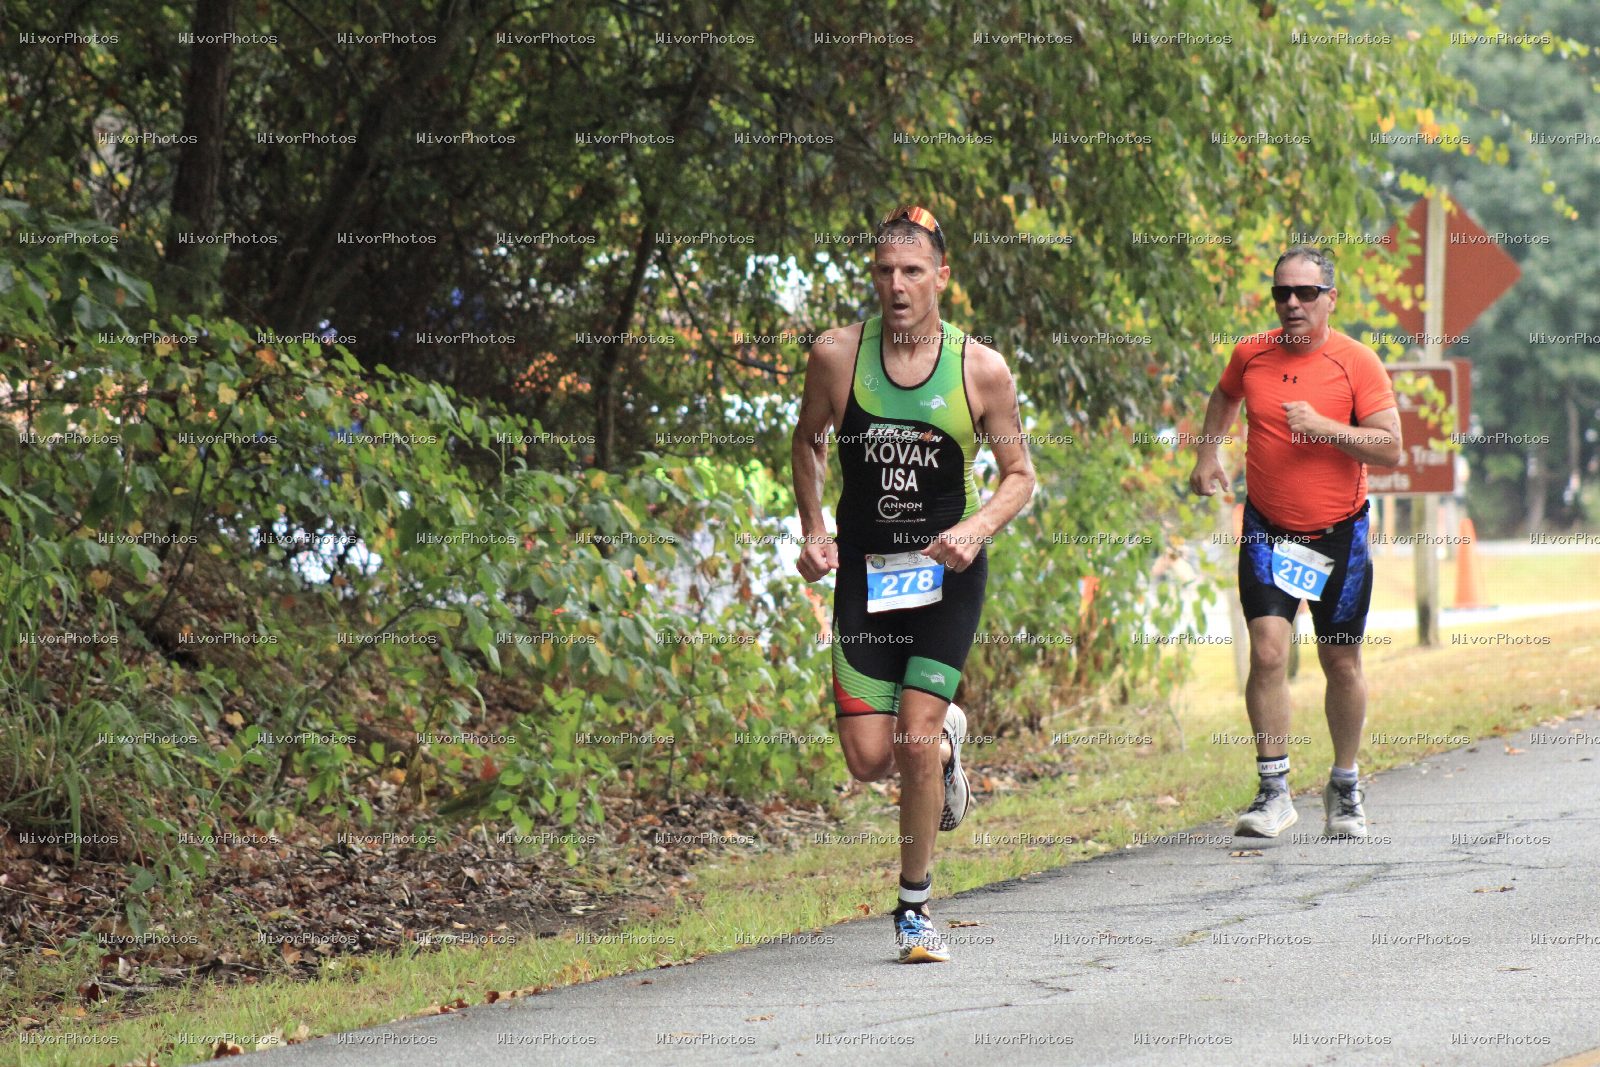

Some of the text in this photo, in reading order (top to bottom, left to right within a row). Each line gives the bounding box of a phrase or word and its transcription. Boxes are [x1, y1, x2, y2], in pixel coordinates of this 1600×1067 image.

[868, 428, 943, 443] EXPLOSIN
[864, 442, 941, 468] KOVAK
[882, 468, 919, 492] USA
[878, 495, 923, 519] CANNON
[881, 569, 934, 597] 278
[1278, 559, 1318, 591] 219
